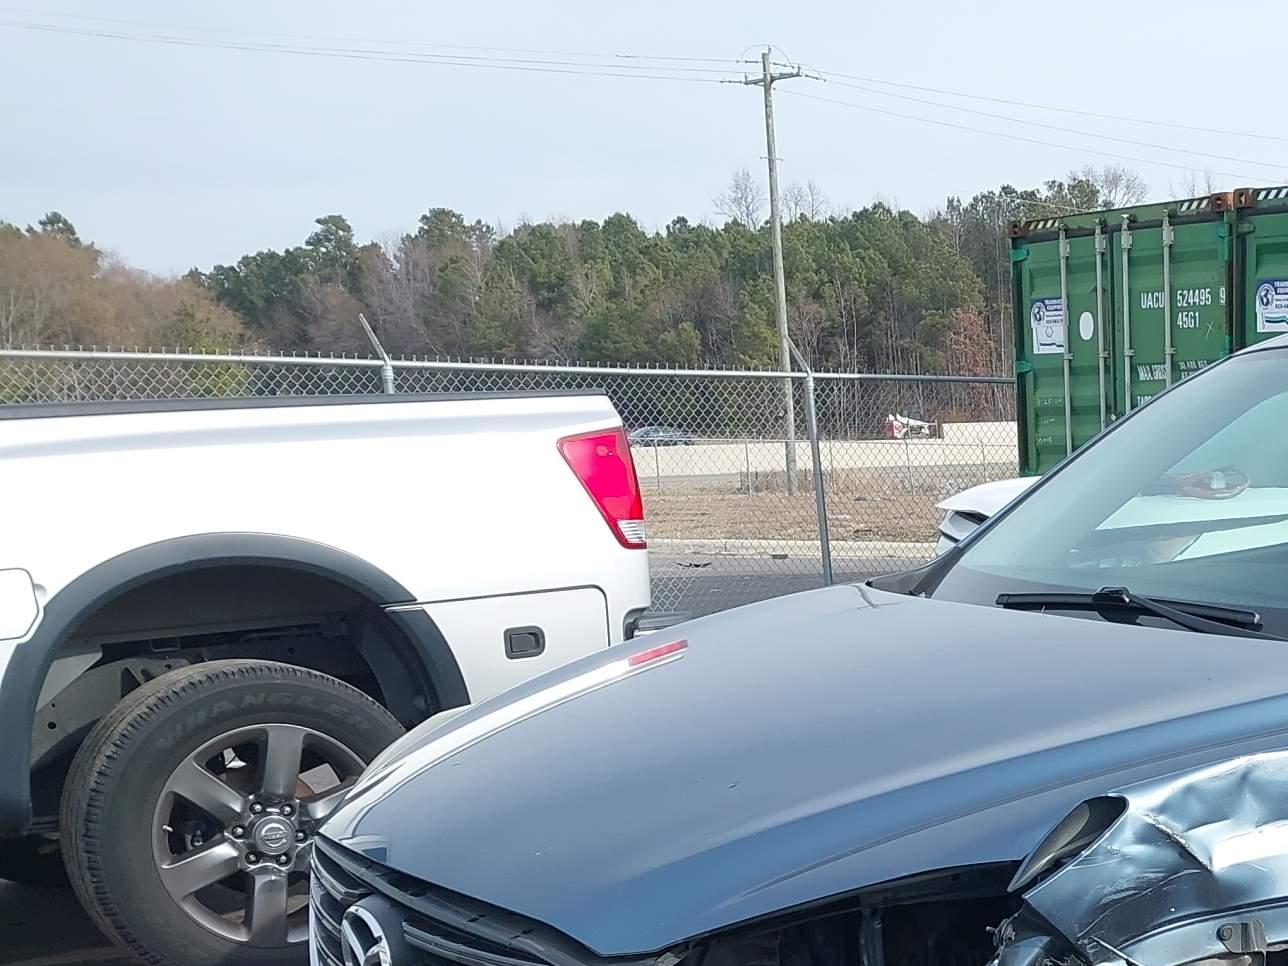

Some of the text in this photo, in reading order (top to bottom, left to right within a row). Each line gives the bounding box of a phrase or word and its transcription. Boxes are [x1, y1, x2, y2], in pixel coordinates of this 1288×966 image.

[1140, 286, 1226, 309] UACU 524495 9
[1177, 311, 1199, 328] 45G1
